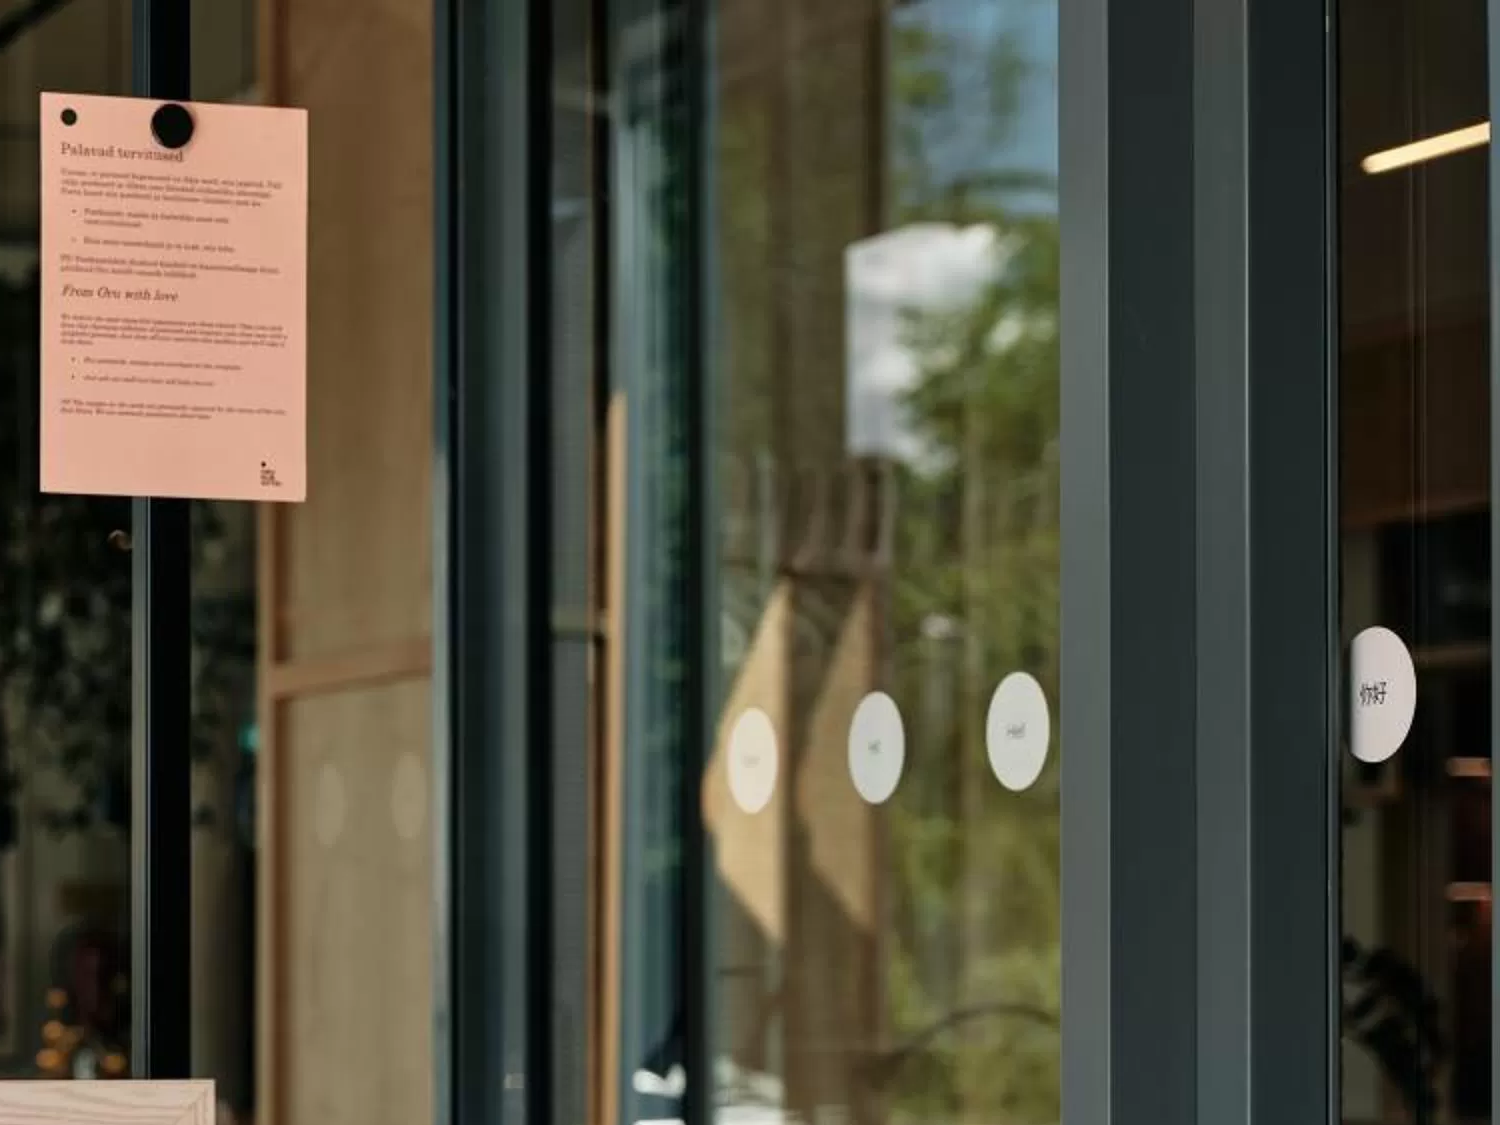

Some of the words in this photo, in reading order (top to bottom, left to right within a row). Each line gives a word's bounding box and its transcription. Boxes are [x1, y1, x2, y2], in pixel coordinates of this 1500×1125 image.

[60, 142, 115, 158] Palavad
[61, 284, 95, 298] From
[124, 289, 151, 301] with
[153, 288, 179, 302] love
[1360, 681, 1387, 706] 你好
